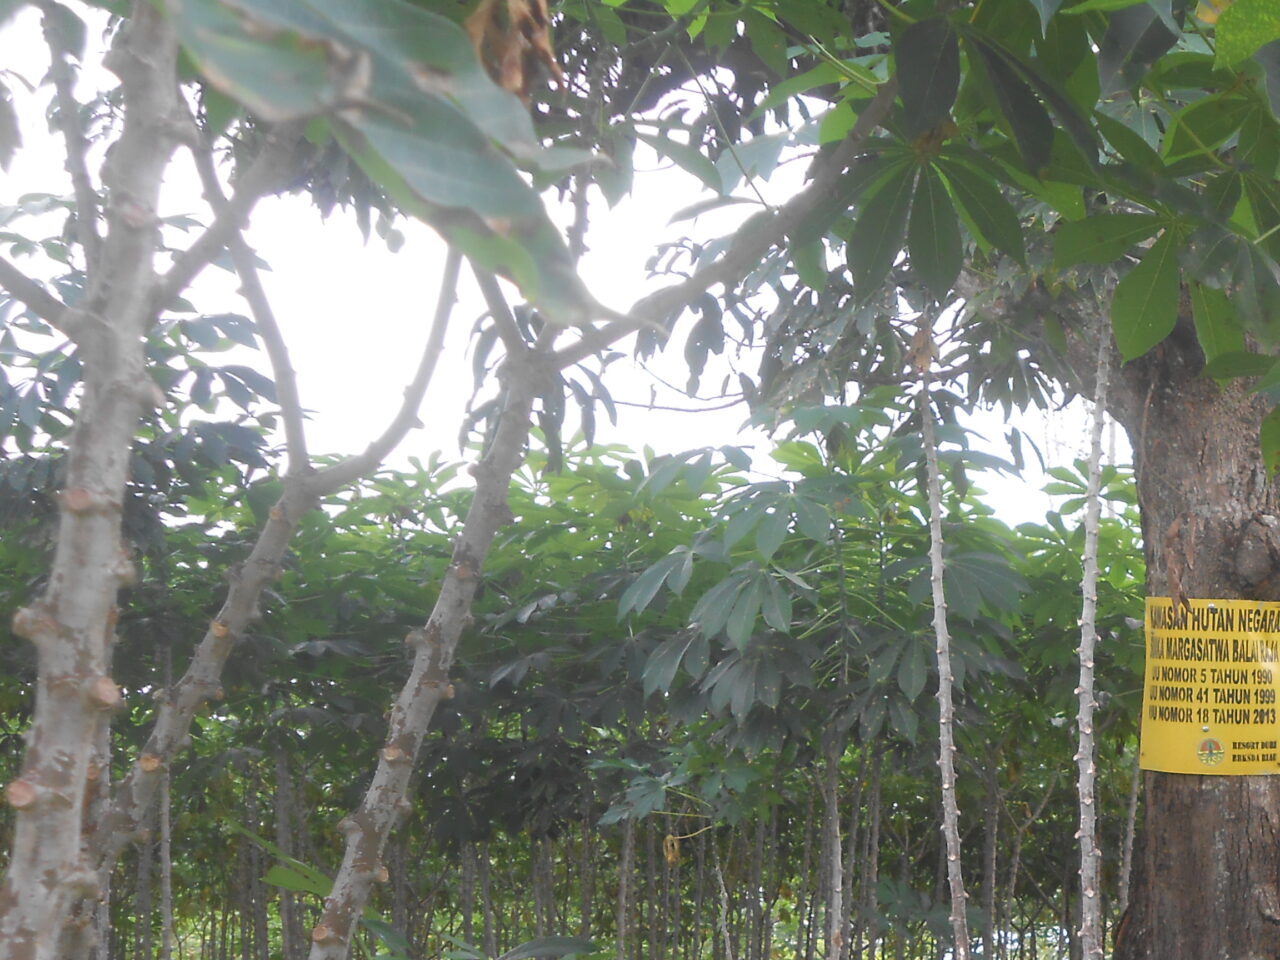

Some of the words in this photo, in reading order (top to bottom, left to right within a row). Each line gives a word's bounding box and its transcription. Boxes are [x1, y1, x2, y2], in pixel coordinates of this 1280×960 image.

[1150, 605, 1188, 630] ASAN
[1192, 607, 1234, 631] HUTAN
[1238, 608, 1280, 633] NEGARA
[1166, 637, 1229, 662] MARGASATWA
[1232, 639, 1259, 662] BALAI
[1162, 666, 1197, 683] NOMOR
[1200, 668, 1207, 683] 5
[1210, 668, 1248, 684] TAHUN
[1251, 669, 1273, 684] 1990
[1159, 685, 1193, 702] NOMOR
[1196, 688, 1209, 703] 41
[1213, 688, 1250, 704] TAHUN
[1253, 688, 1276, 704] 1999
[1158, 705, 1193, 723] NOMOR
[1196, 707, 1209, 723] 18
[1212, 708, 1250, 724] TAHUN
[1253, 708, 1276, 724] 2013
